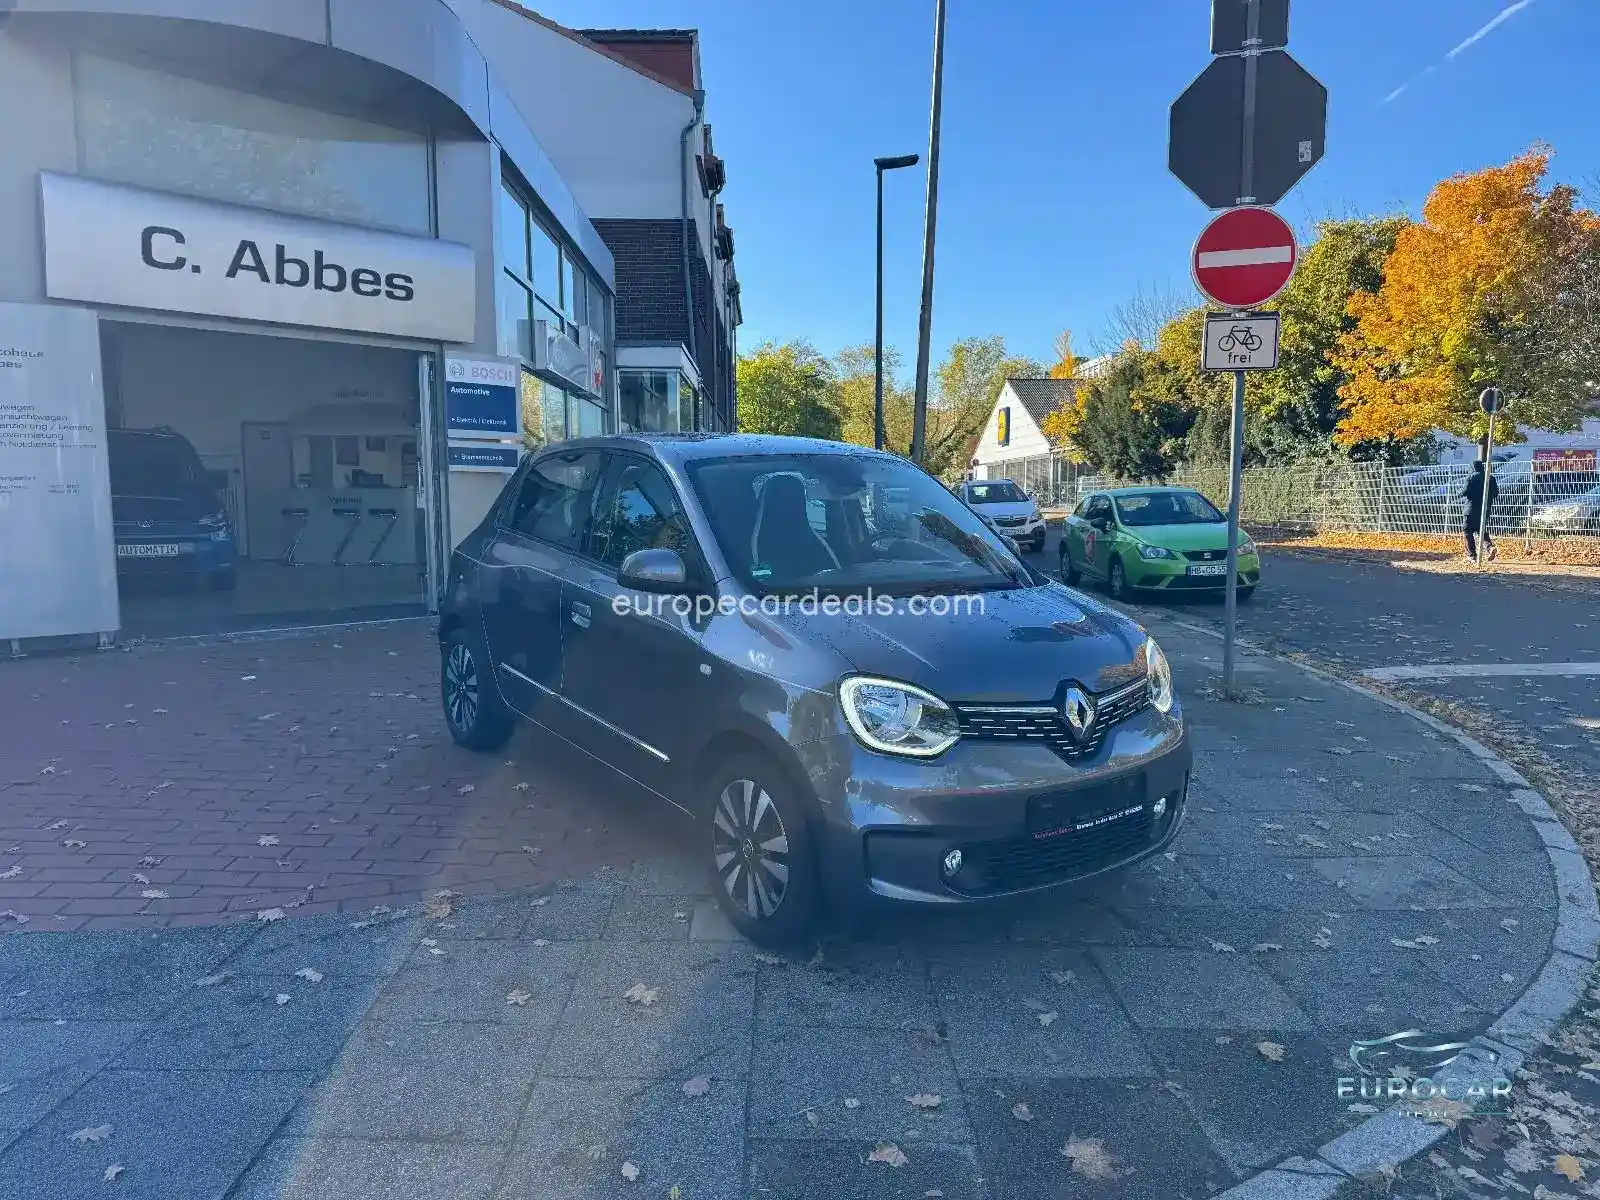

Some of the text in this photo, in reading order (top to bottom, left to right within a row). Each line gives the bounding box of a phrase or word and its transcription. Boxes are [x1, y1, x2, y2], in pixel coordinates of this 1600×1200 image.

[140, 225, 415, 302] C. Abbes
[1228, 352, 1252, 363] frei
[471, 366, 513, 381] BOSCH
[450, 386, 490, 396] Automotive
[119, 545, 178, 555] AUTOMATIK
